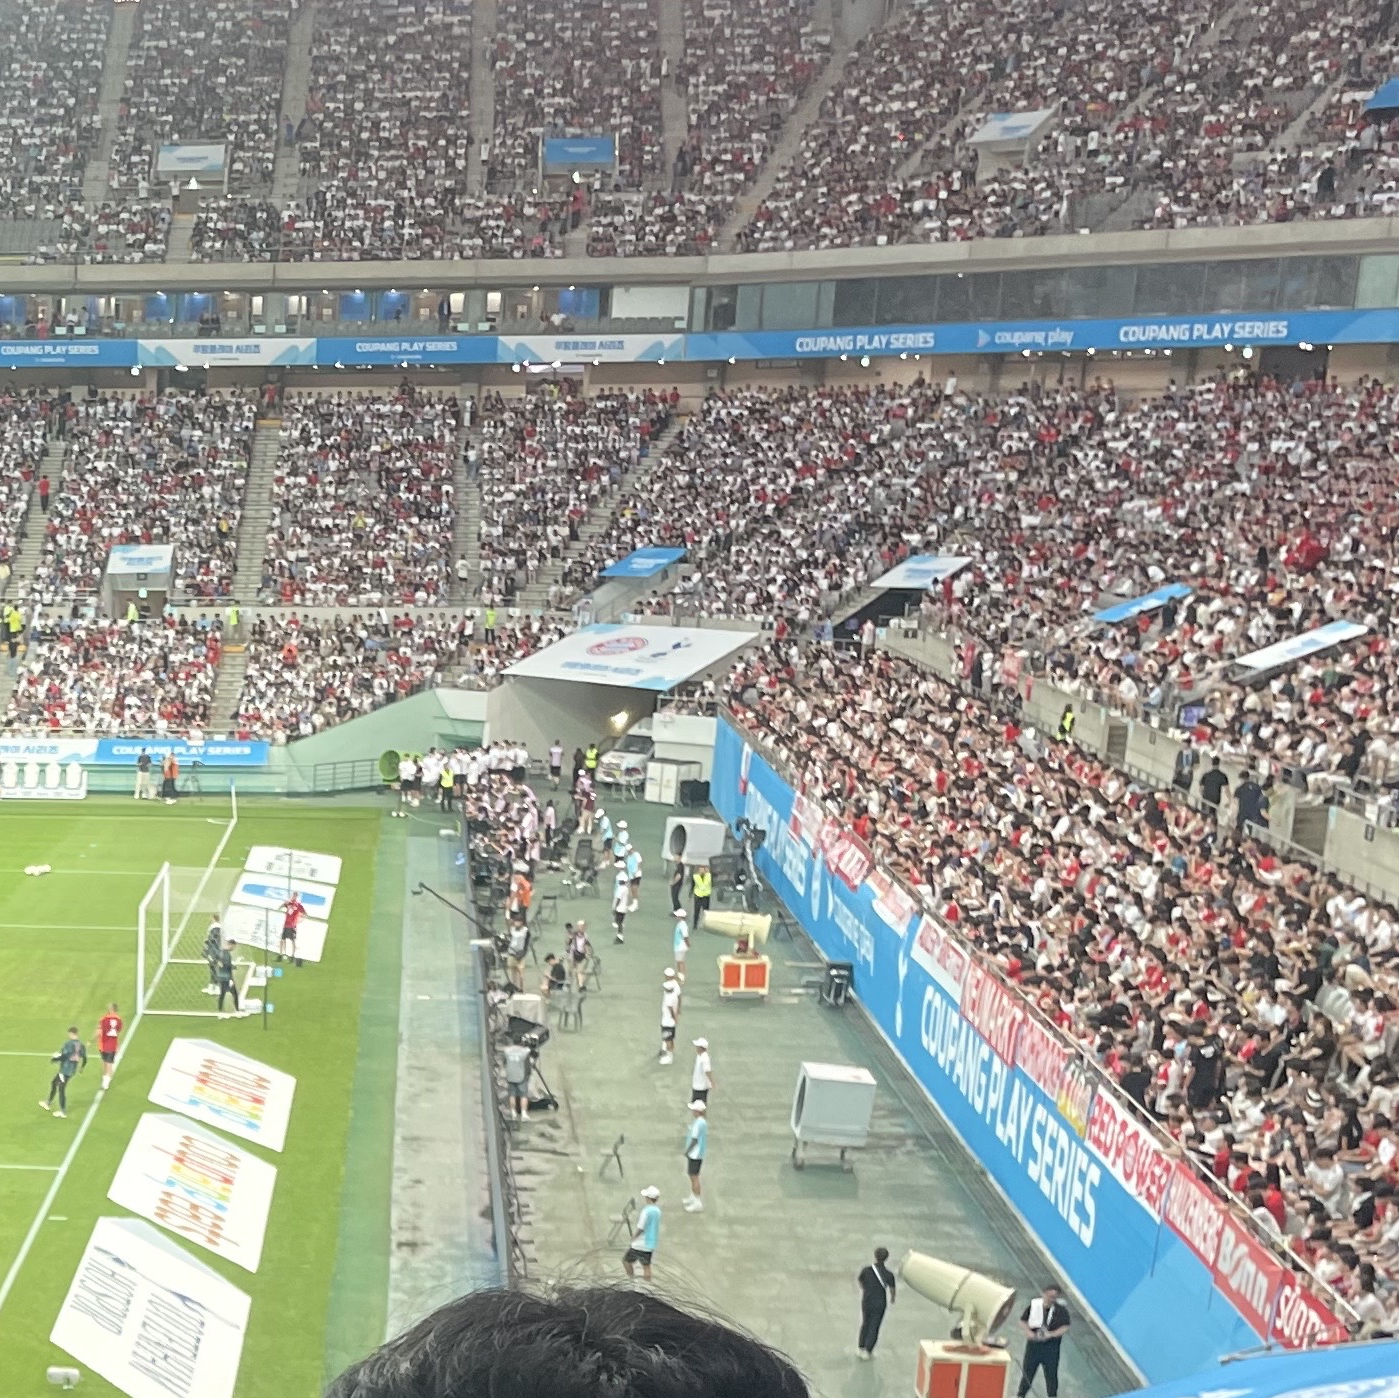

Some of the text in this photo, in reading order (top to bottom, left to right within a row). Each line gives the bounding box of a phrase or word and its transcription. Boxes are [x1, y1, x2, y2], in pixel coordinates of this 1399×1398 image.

[995, 328, 1074, 346] coupang play
[1120, 321, 1288, 342] COUPANG PLAY SERIES
[1, 345, 99, 355] COUPANG PLAY SERIES
[356, 341, 458, 352] COUPANG PLAY SERIES
[796, 332, 935, 353] COUPANG PLAY SERIES
[174, 746, 205, 756] PLAY
[208, 746, 251, 756] SERIES
[921, 985, 989, 1115] COUPANG
[986, 1052, 1034, 1165] PLAY
[1027, 1104, 1101, 1248] SERIES
[1088, 1093, 1171, 1216] RED POWER
